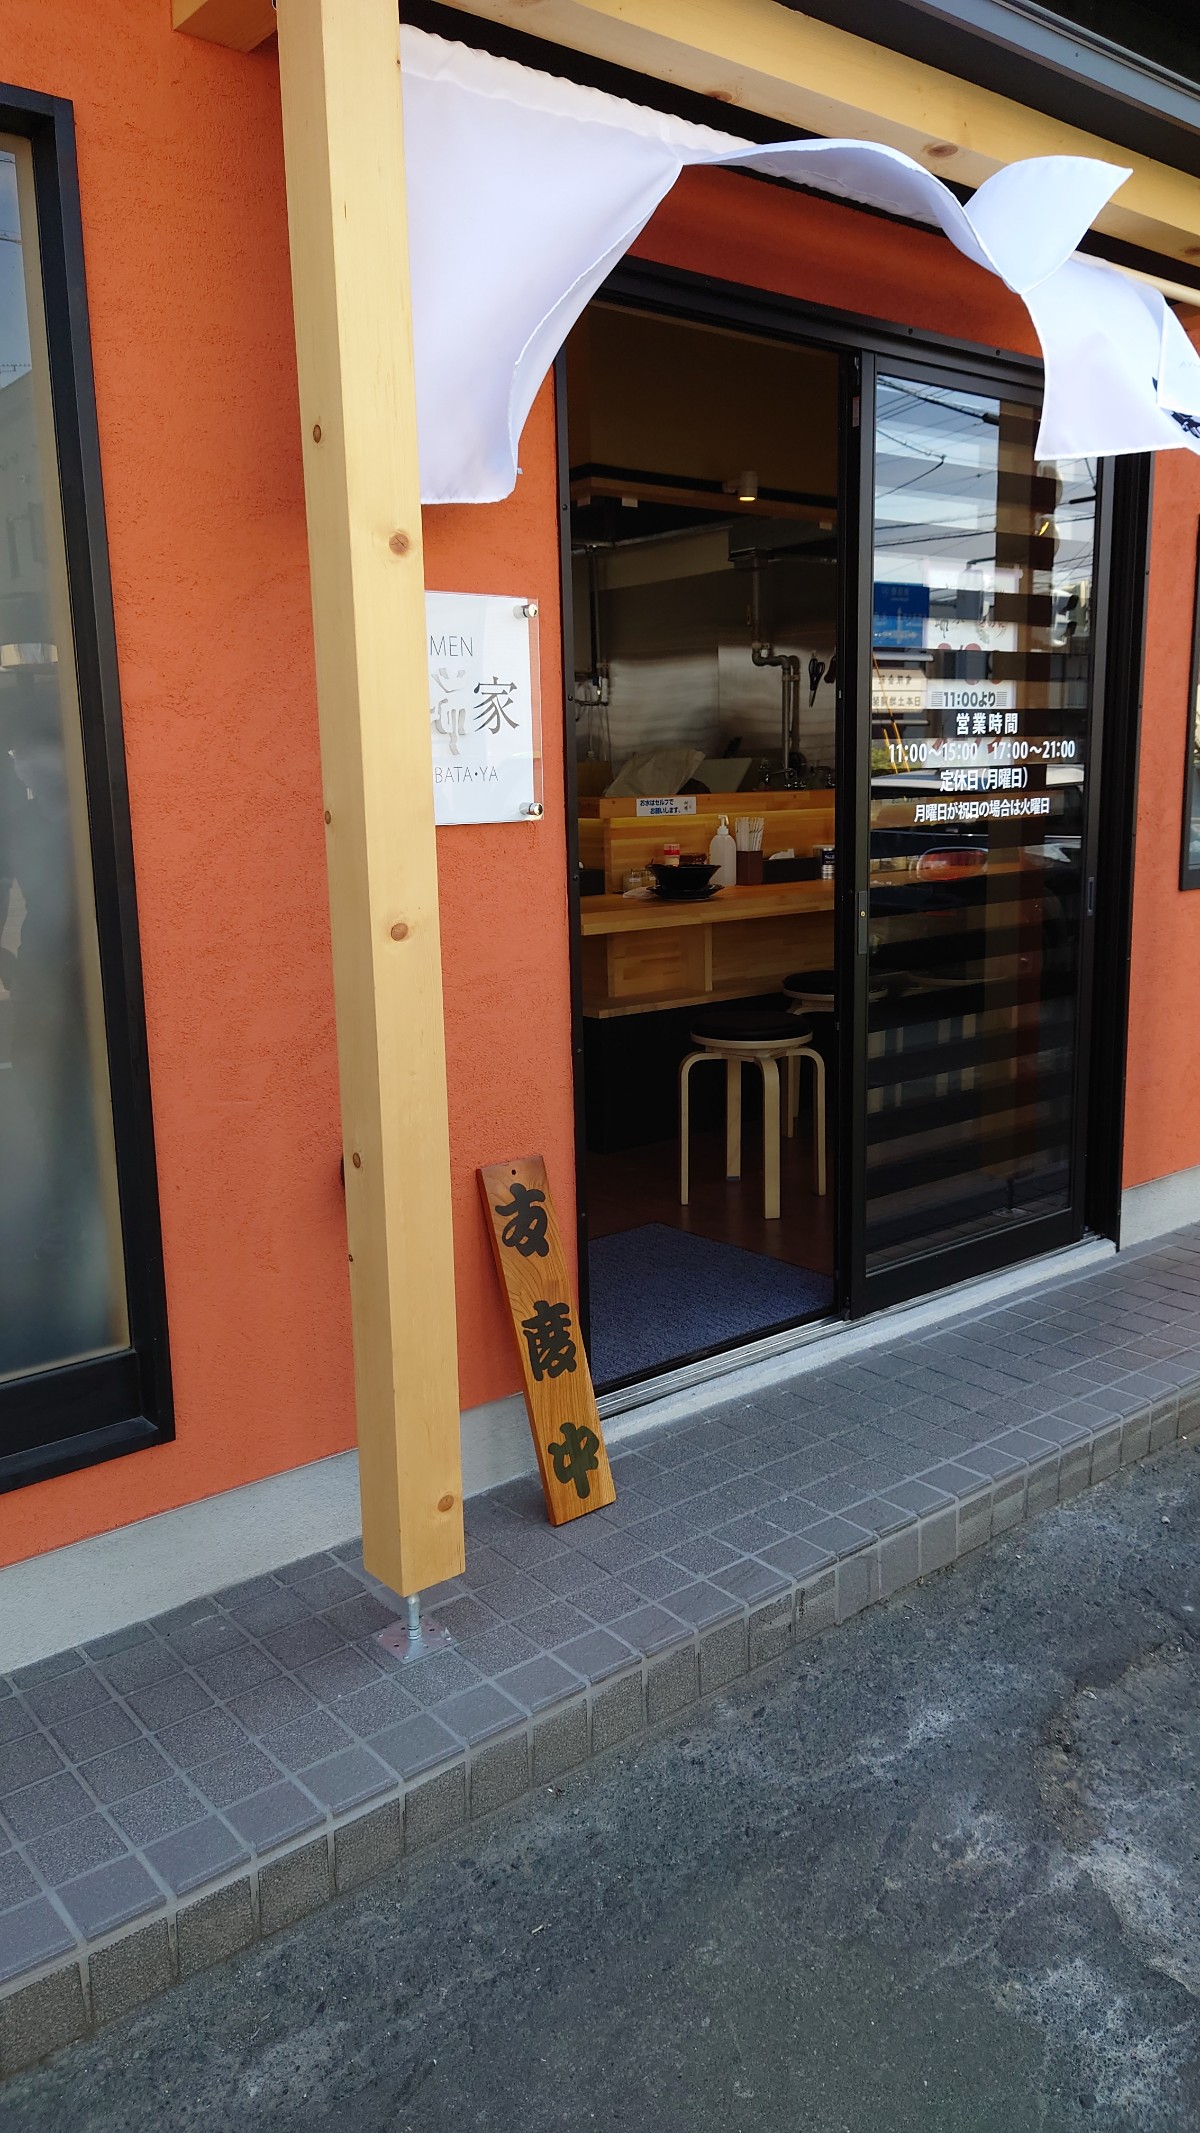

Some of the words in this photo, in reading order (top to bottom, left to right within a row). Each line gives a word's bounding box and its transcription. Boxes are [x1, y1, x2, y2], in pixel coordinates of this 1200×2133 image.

[473, 675, 520, 735] 家
[956, 712, 1019, 735] 営業時間
[914, 797, 1050, 823] 月曜日が祝日の場合は火曜日
